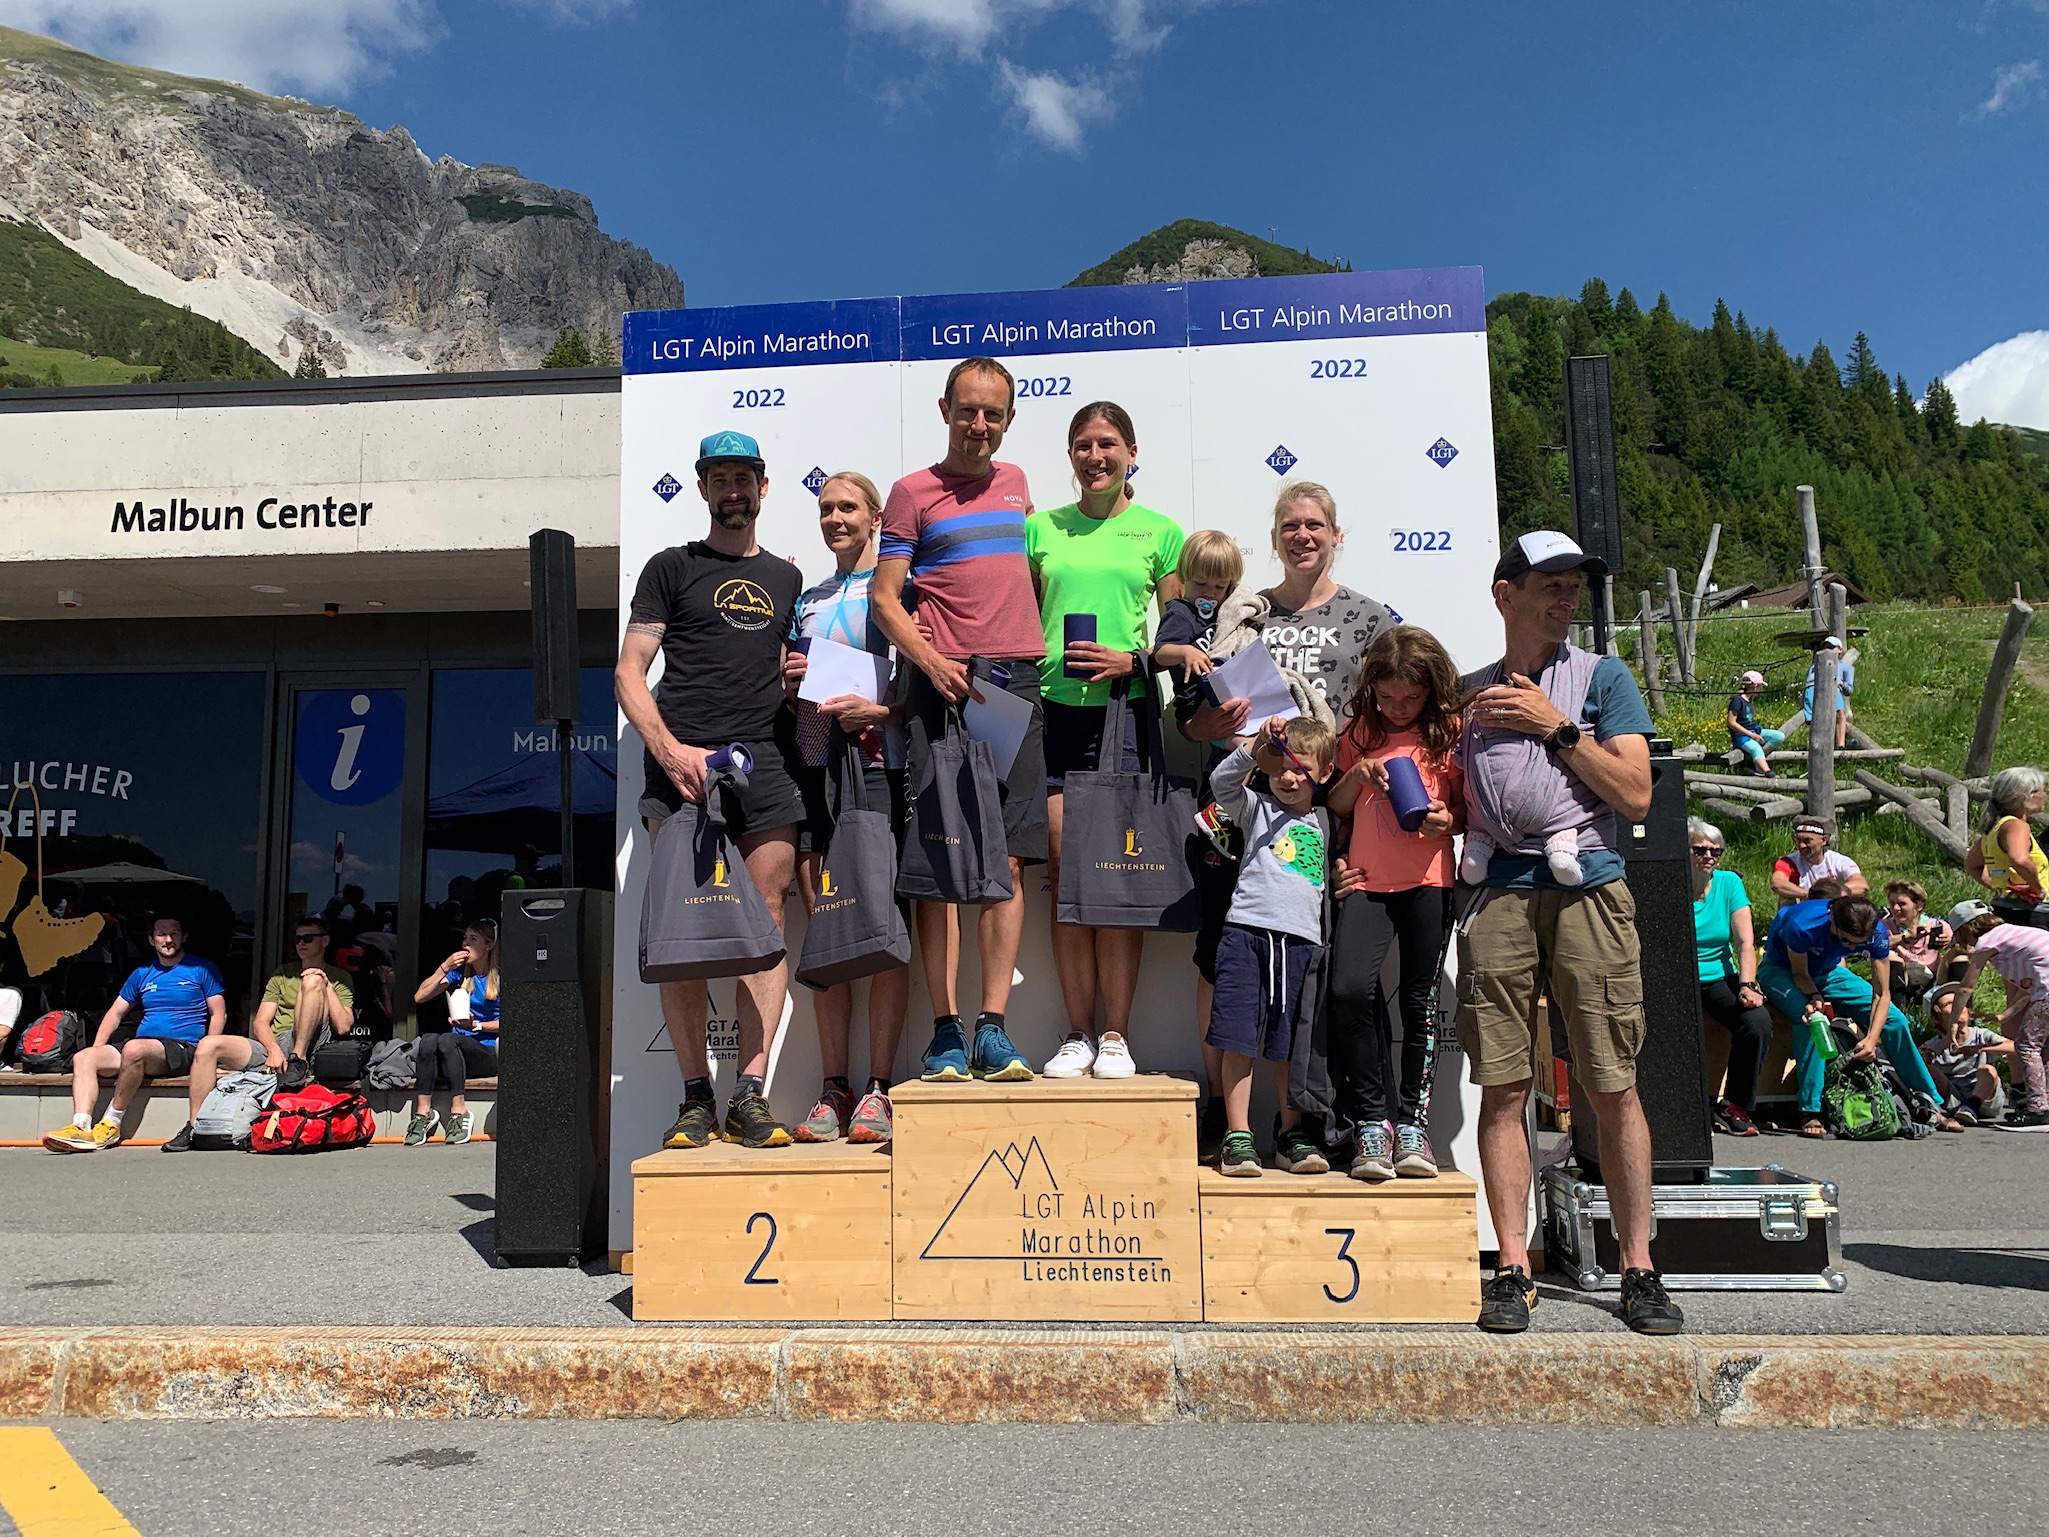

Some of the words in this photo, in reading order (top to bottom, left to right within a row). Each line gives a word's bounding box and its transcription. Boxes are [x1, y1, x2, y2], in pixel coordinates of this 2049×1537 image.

[1220, 308, 1265, 331] LGT
[1272, 305, 1331, 331] Alpin
[1339, 300, 1452, 324] Marathon
[932, 324, 975, 346] LGT
[981, 321, 1038, 348] Alpin
[1047, 316, 1156, 340] Marathon
[652, 338, 694, 360] LGT
[700, 334, 755, 361] Alpin
[763, 330, 869, 353] Marathon
[1310, 358, 1368, 379] 2022
[1016, 376, 1072, 398] 2022
[732, 388, 786, 409] 2022
[1270, 455, 1294, 467] LGT
[1431, 447, 1454, 459] LGT
[657, 482, 678, 494] LGT
[111, 498, 244, 532] Malbun
[256, 496, 373, 529] Center
[1392, 530, 1453, 552] 2022
[728, 602, 775, 618] SPORTIVA
[1261, 625, 1340, 647] ROCK
[1270, 647, 1322, 674] THE
[1095, 861, 1165, 871] LIECHTENSTEIN
[810, 897, 857, 915] CHTENSTEIN
[706, 1020, 728, 1032] GT
[1022, 1193, 1065, 1219] LGT
[1082, 1193, 1156, 1226] Alpin
[744, 1212, 779, 1284] 2
[1022, 1228, 1141, 1254] Marathon
[1022, 1261, 1172, 1283] Liechtenstein
[1323, 1228, 1361, 1304] 3
